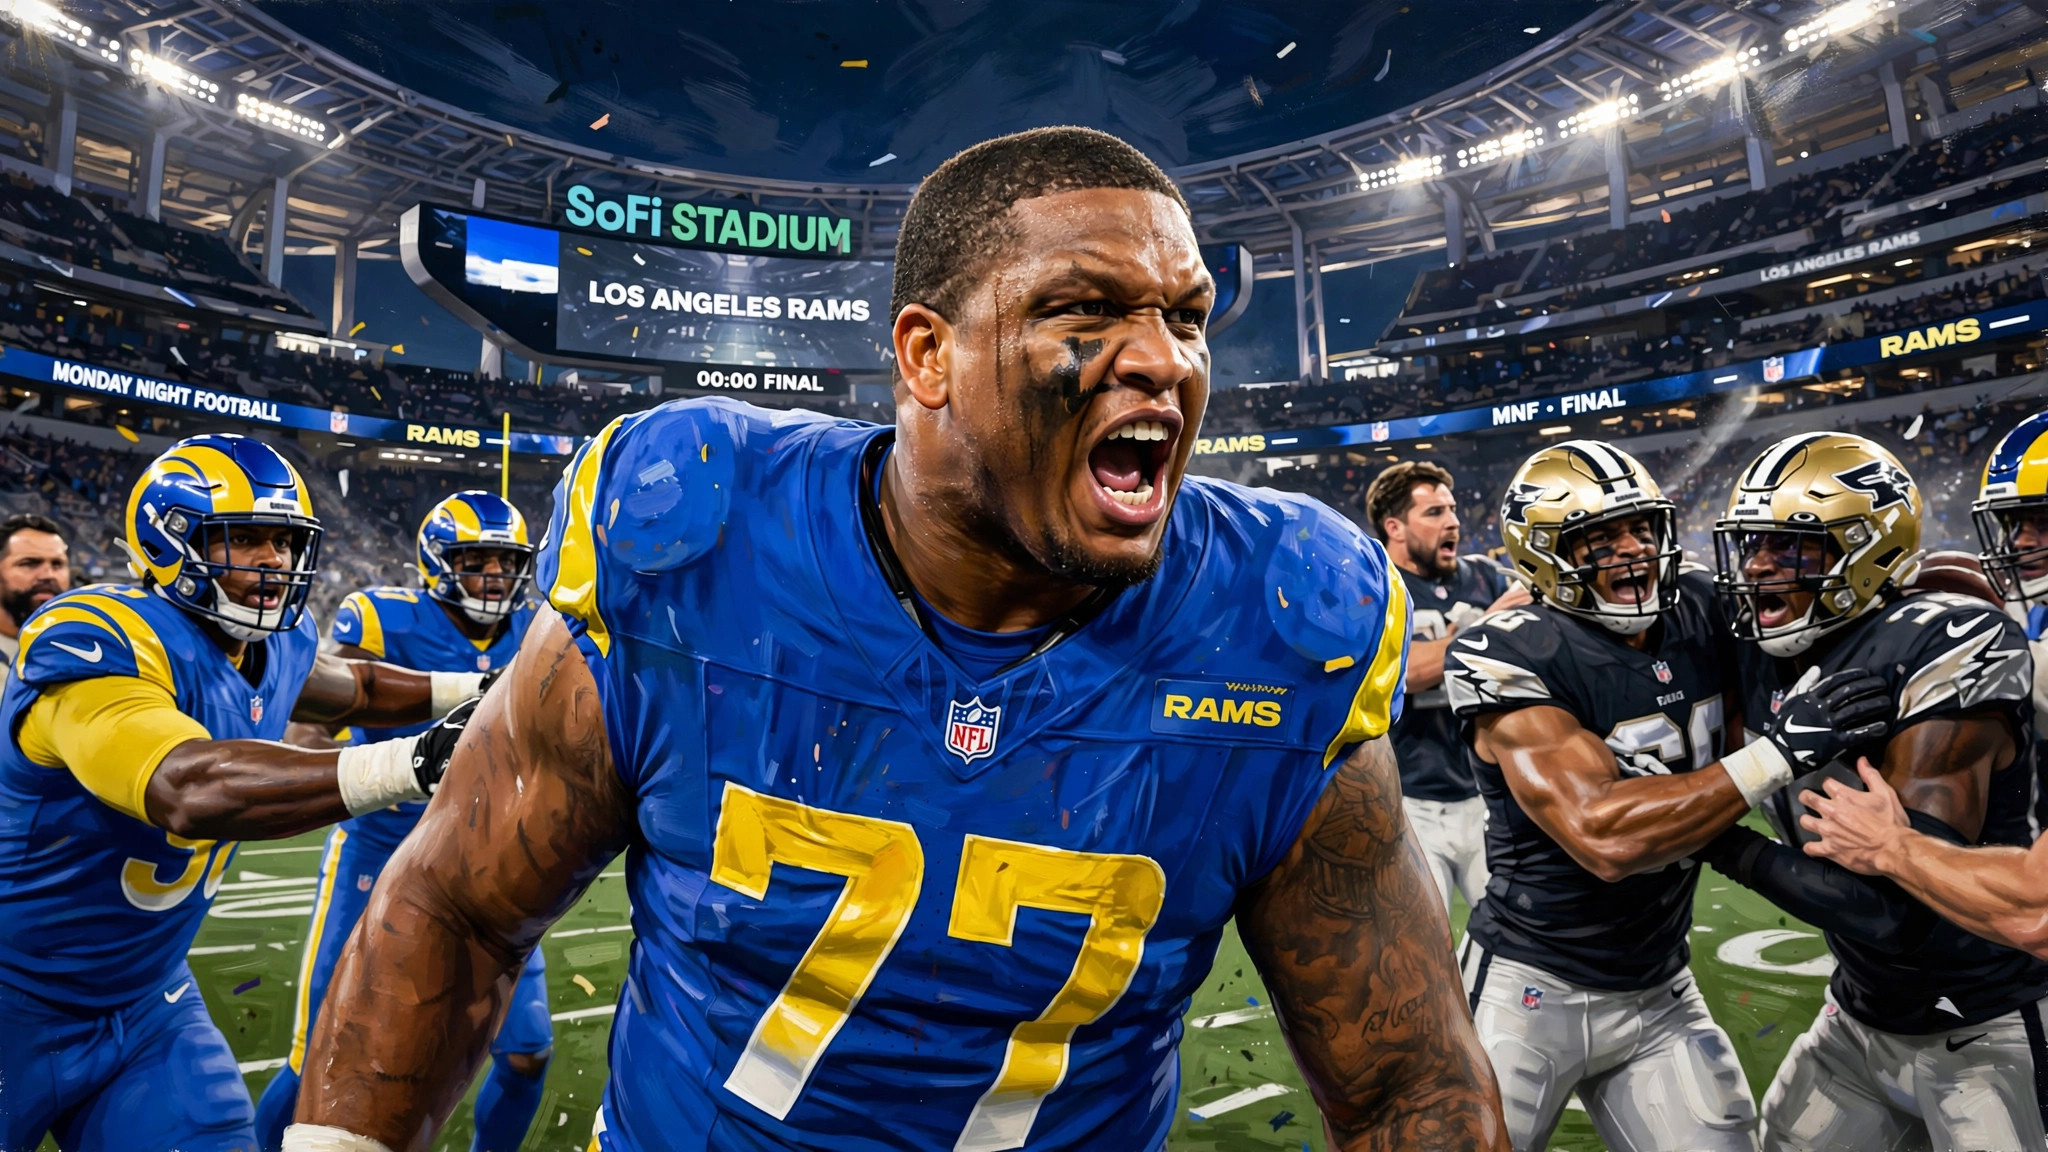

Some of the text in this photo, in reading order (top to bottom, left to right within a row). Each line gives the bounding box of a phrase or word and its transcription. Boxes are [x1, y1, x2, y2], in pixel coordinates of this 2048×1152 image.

[565, 185, 851, 253] SoFi STADIUM
[1760, 231, 1921, 282] LOS ANGELES RAMS
[589, 280, 870, 322] LOS ANGELES RAMS
[1880, 318, 1981, 358] RAMS
[52, 360, 282, 422] MONDAY NIGHT FOOTBALL
[696, 370, 824, 392] 00:00 FINAL
[1492, 401, 1540, 426] MNF
[1561, 388, 1627, 416] FINAL
[406, 424, 480, 448] RAMS
[1195, 434, 1266, 455] RAMS
[1163, 694, 1282, 727] RAMS
[952, 724, 989, 752] NFL
[710, 780, 1167, 1152] 77
